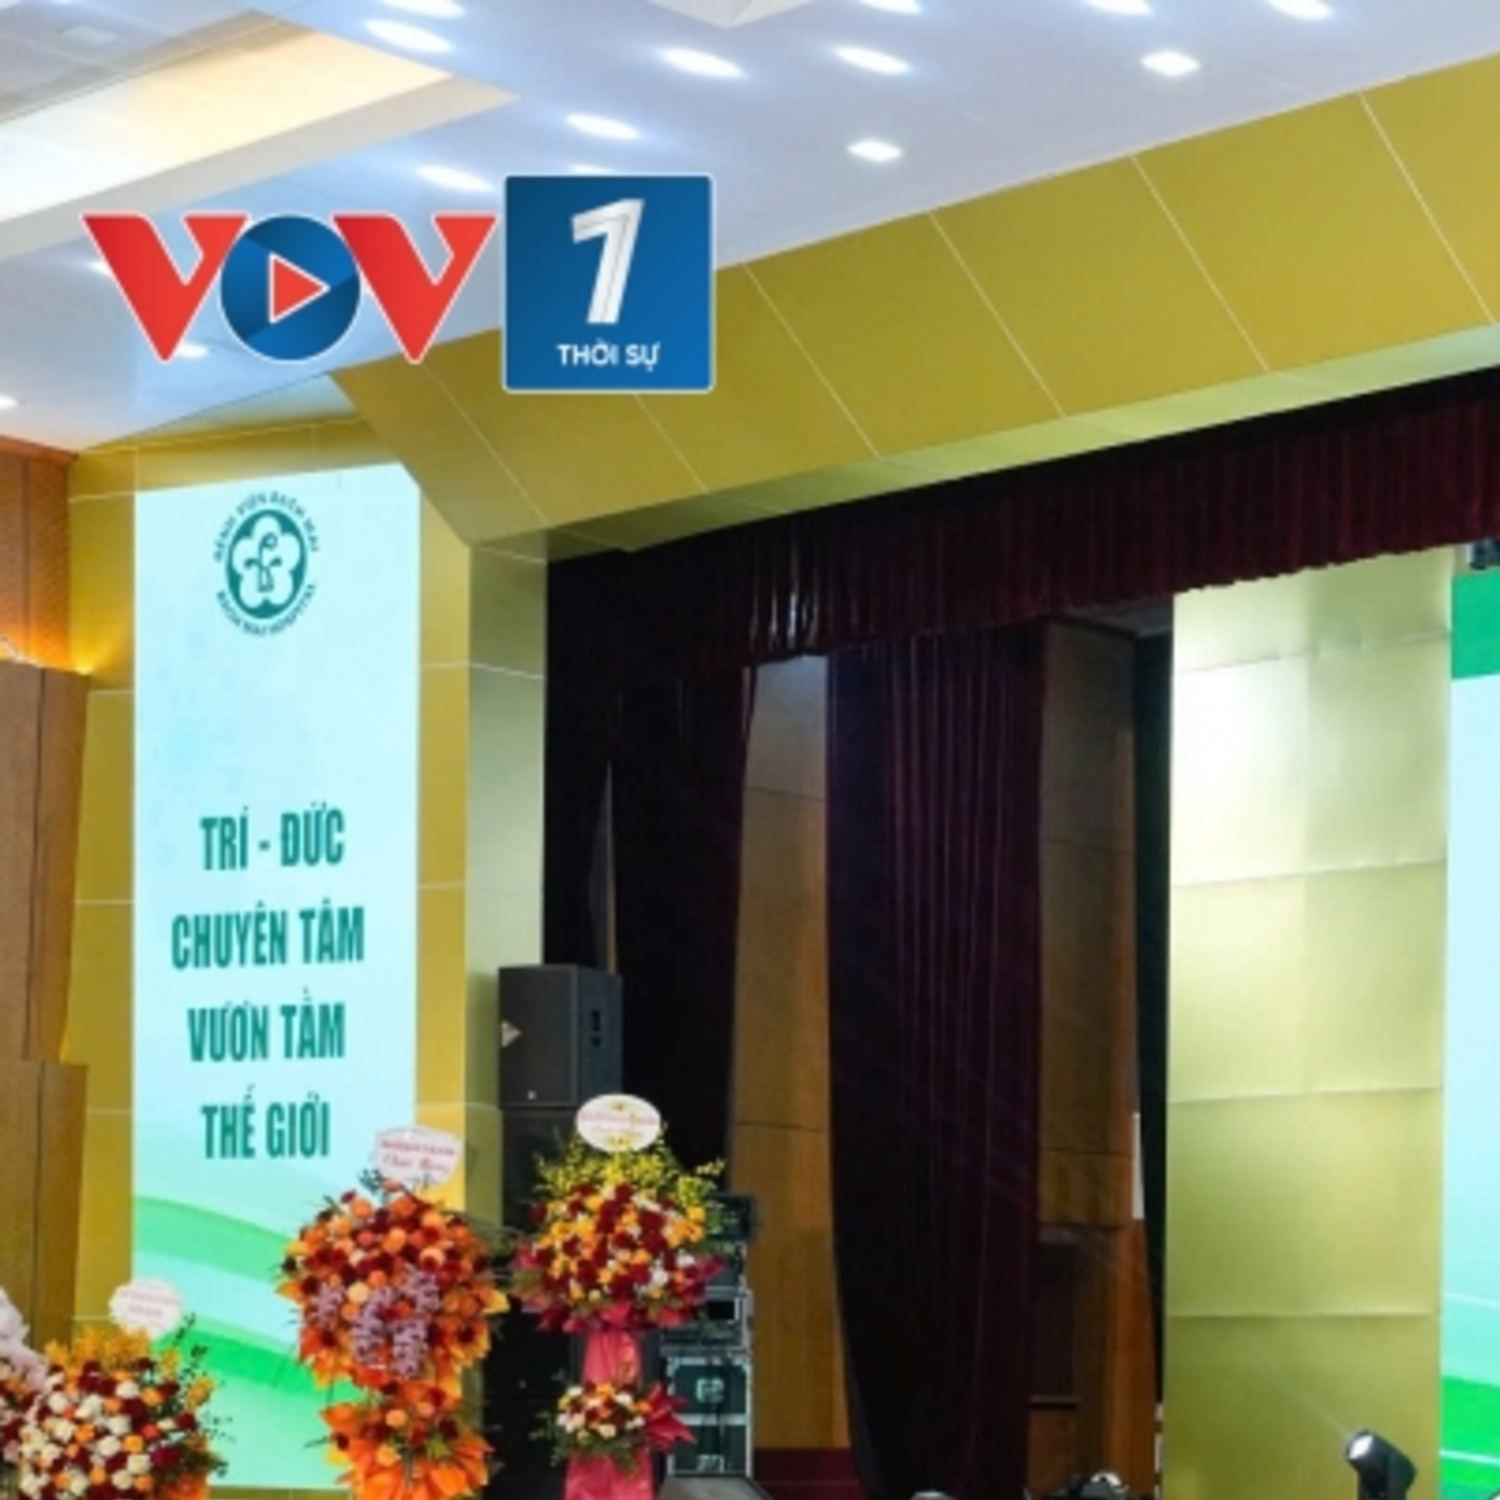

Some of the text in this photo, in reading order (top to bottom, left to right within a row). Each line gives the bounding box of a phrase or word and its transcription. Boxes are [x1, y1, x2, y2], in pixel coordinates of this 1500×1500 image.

[200, 805, 249, 871] TRÍ
[280, 800, 345, 867] ĐỨC
[171, 896, 364, 969] CHUYÊN TÂM
[187, 986, 346, 1062] VƯƠN TẦM
[201, 1083, 331, 1159] THẾ GIỚI
